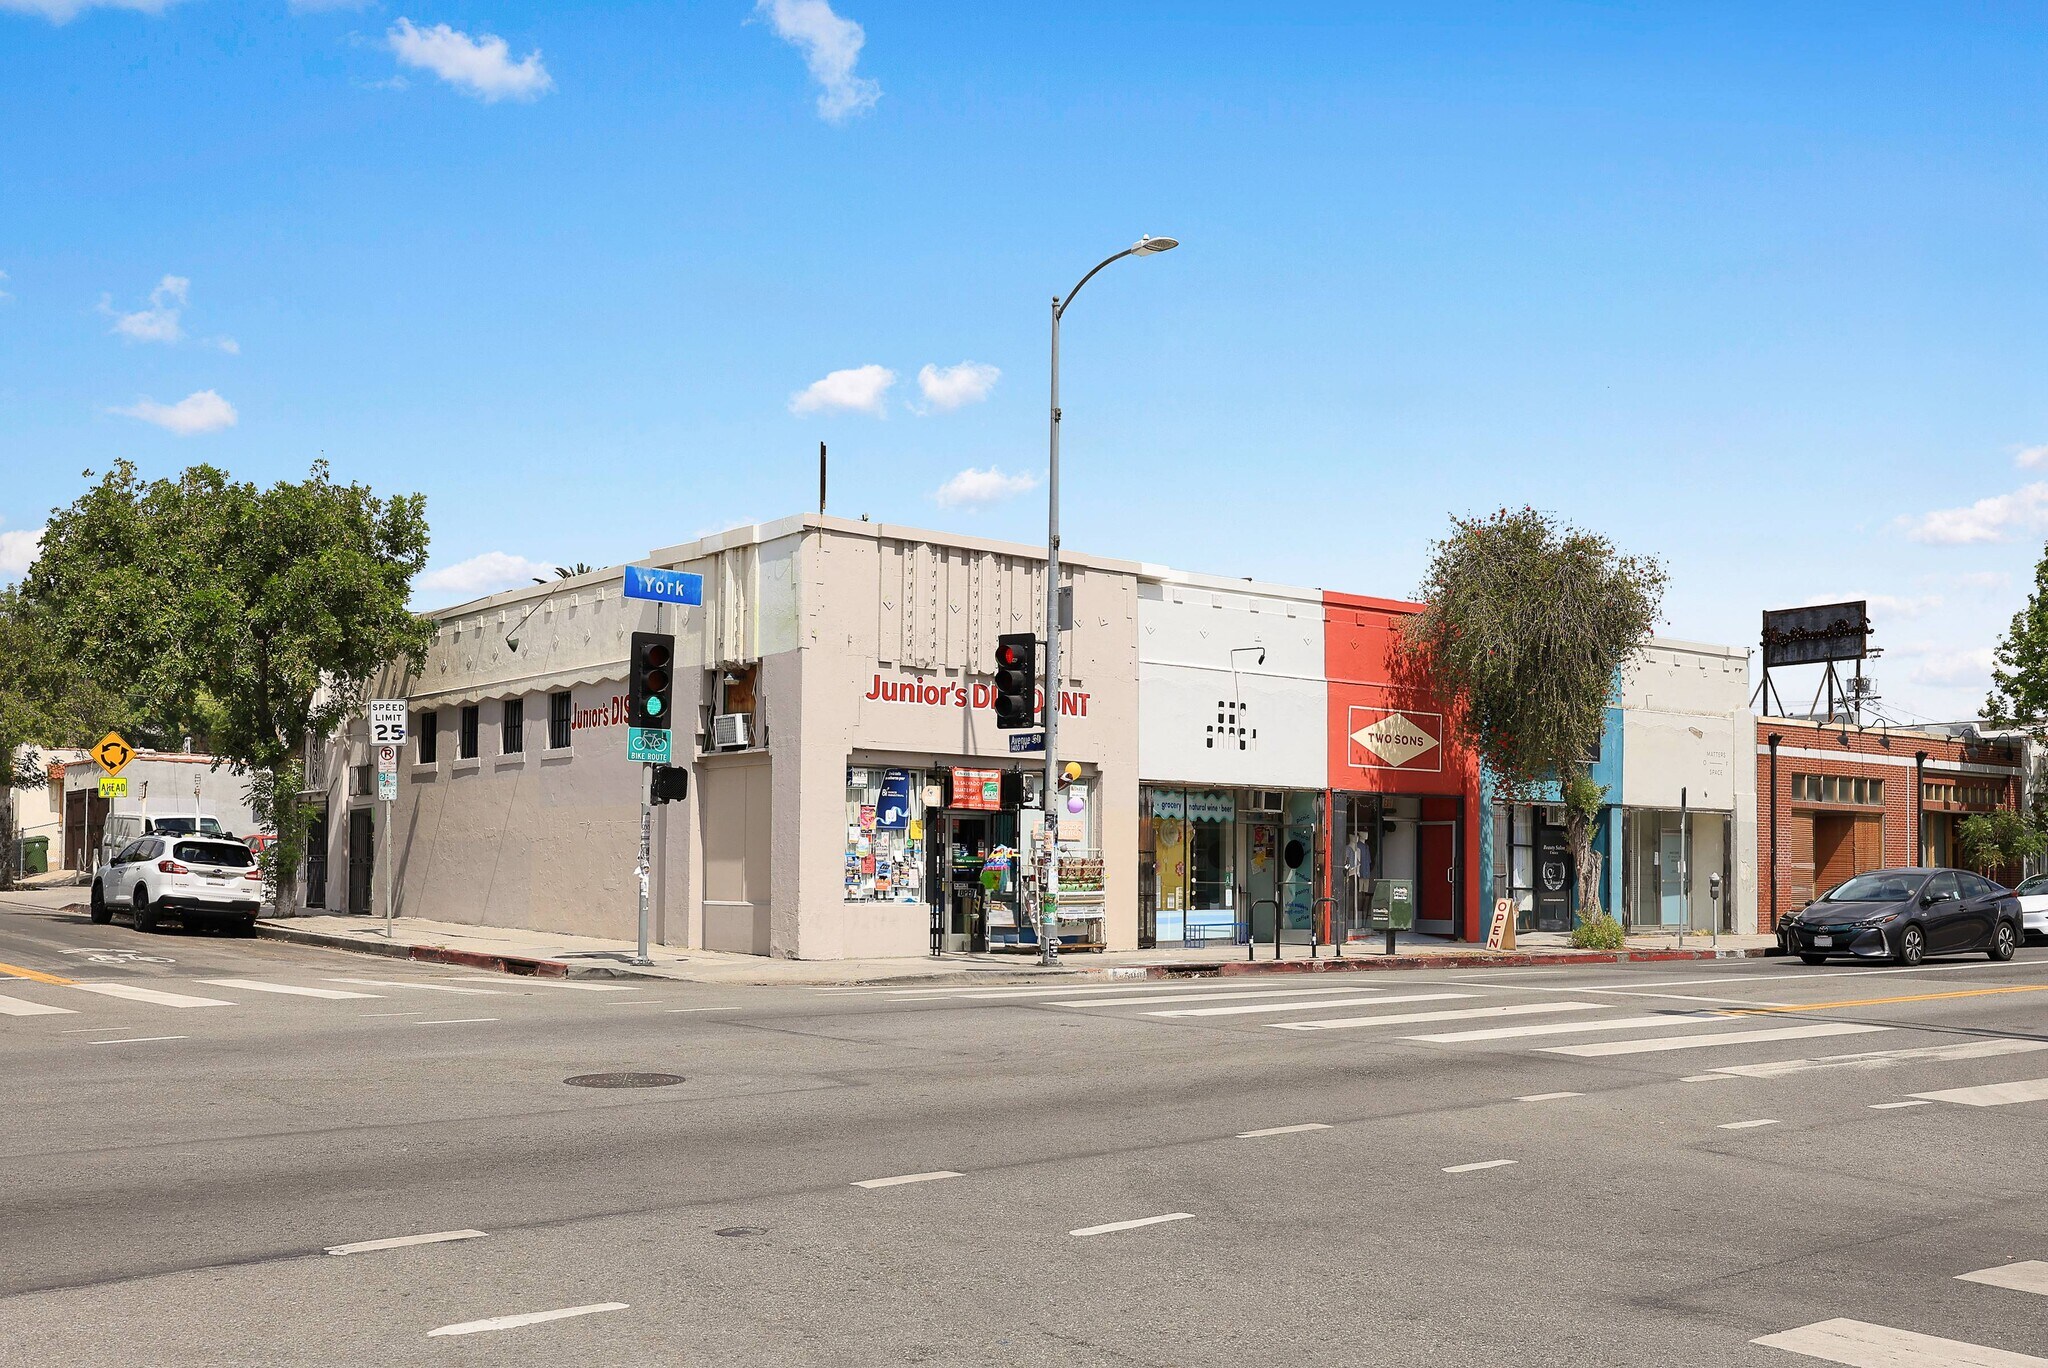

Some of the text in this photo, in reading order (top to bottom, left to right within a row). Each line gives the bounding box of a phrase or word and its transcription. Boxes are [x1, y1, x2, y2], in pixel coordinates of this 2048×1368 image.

[644, 576, 684, 596] York
[866, 674, 967, 707] Junior's
[372, 703, 404, 711] SPEED
[571, 702, 609, 730] Junior's
[374, 724, 404, 741] 25
[1368, 733, 1424, 747] TWO SONS
[631, 752, 667, 761] BIKE ROUTE
[380, 773, 385, 781] 2
[101, 783, 126, 792] AHEAD
[1161, 801, 1182, 811] grocery
[1188, 803, 1233, 813] natural wine beer
[1489, 902, 1507, 949] OPEN
